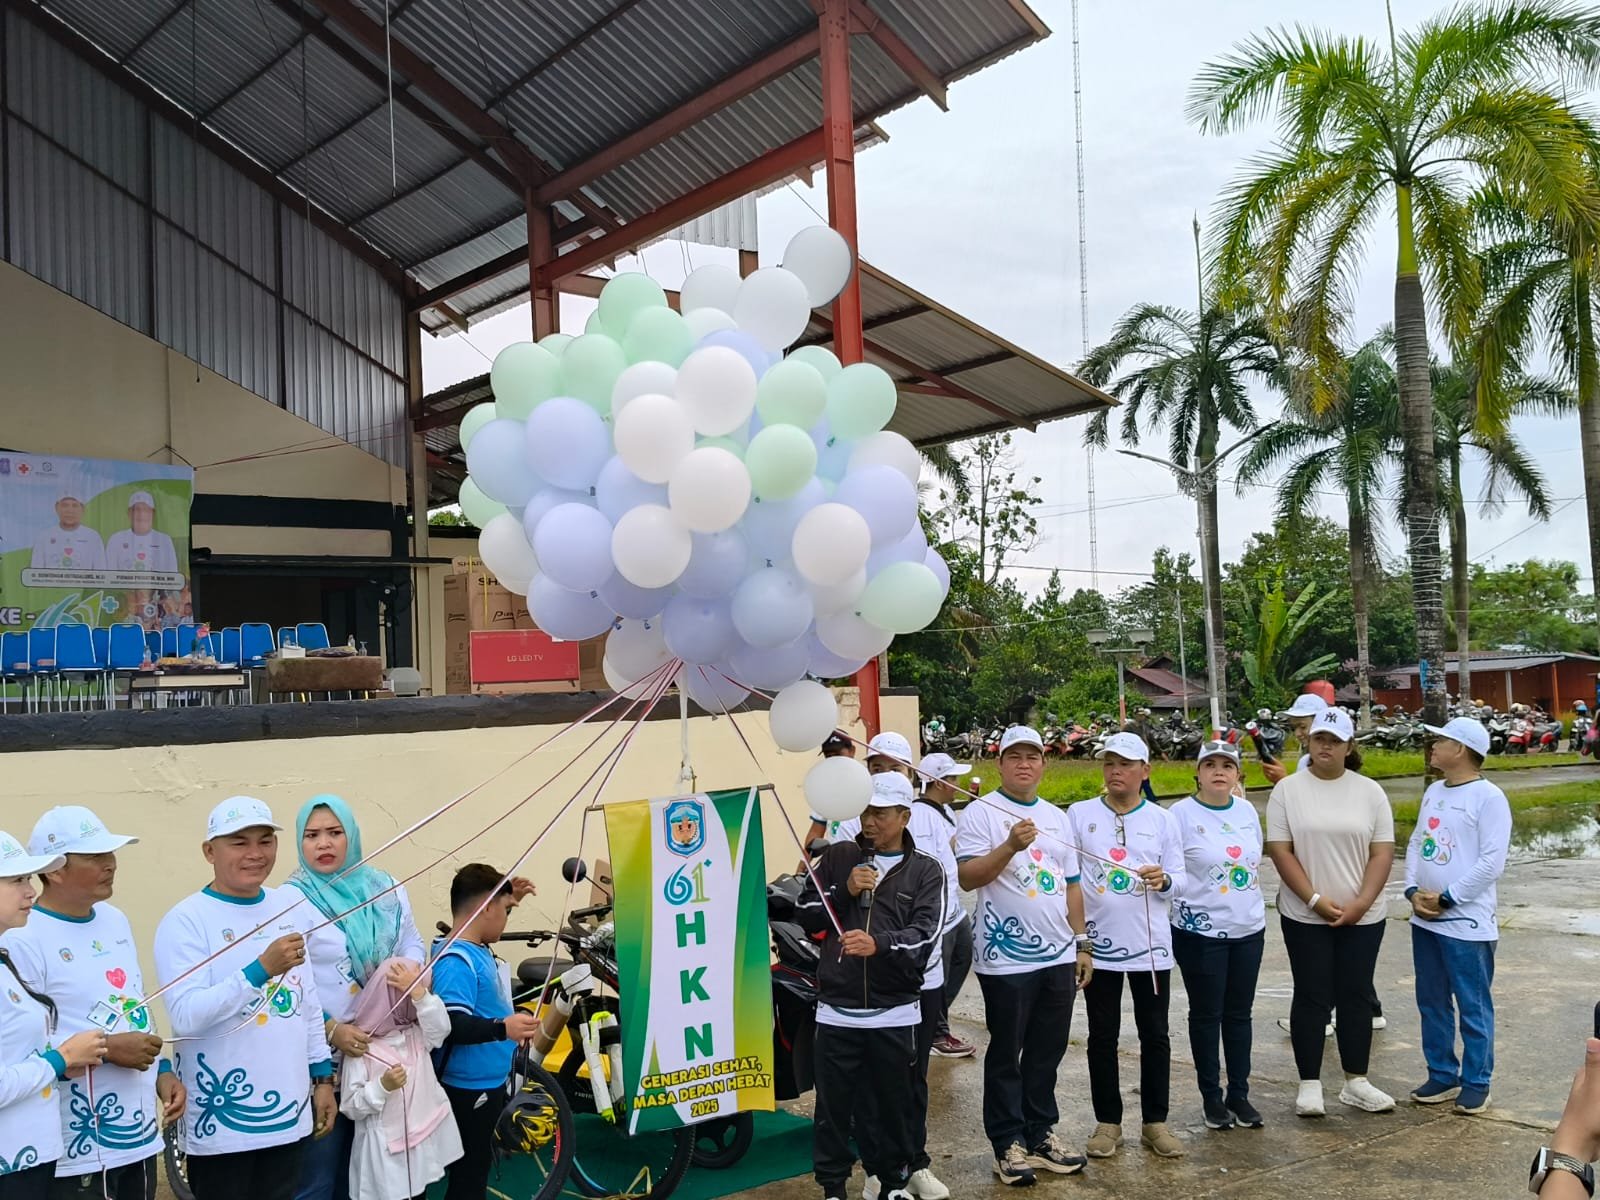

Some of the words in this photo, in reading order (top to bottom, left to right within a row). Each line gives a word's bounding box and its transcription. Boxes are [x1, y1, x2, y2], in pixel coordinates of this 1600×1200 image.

[507, 655, 517, 663] LG
[641, 1063, 711, 1090] GENERASI
[711, 1055, 763, 1078] SEHAT,
[633, 1092, 678, 1110] MASA
[679, 1080, 725, 1103] DEPAN
[727, 1073, 772, 1091] HEBAT
[690, 1099, 720, 1118] 2025
